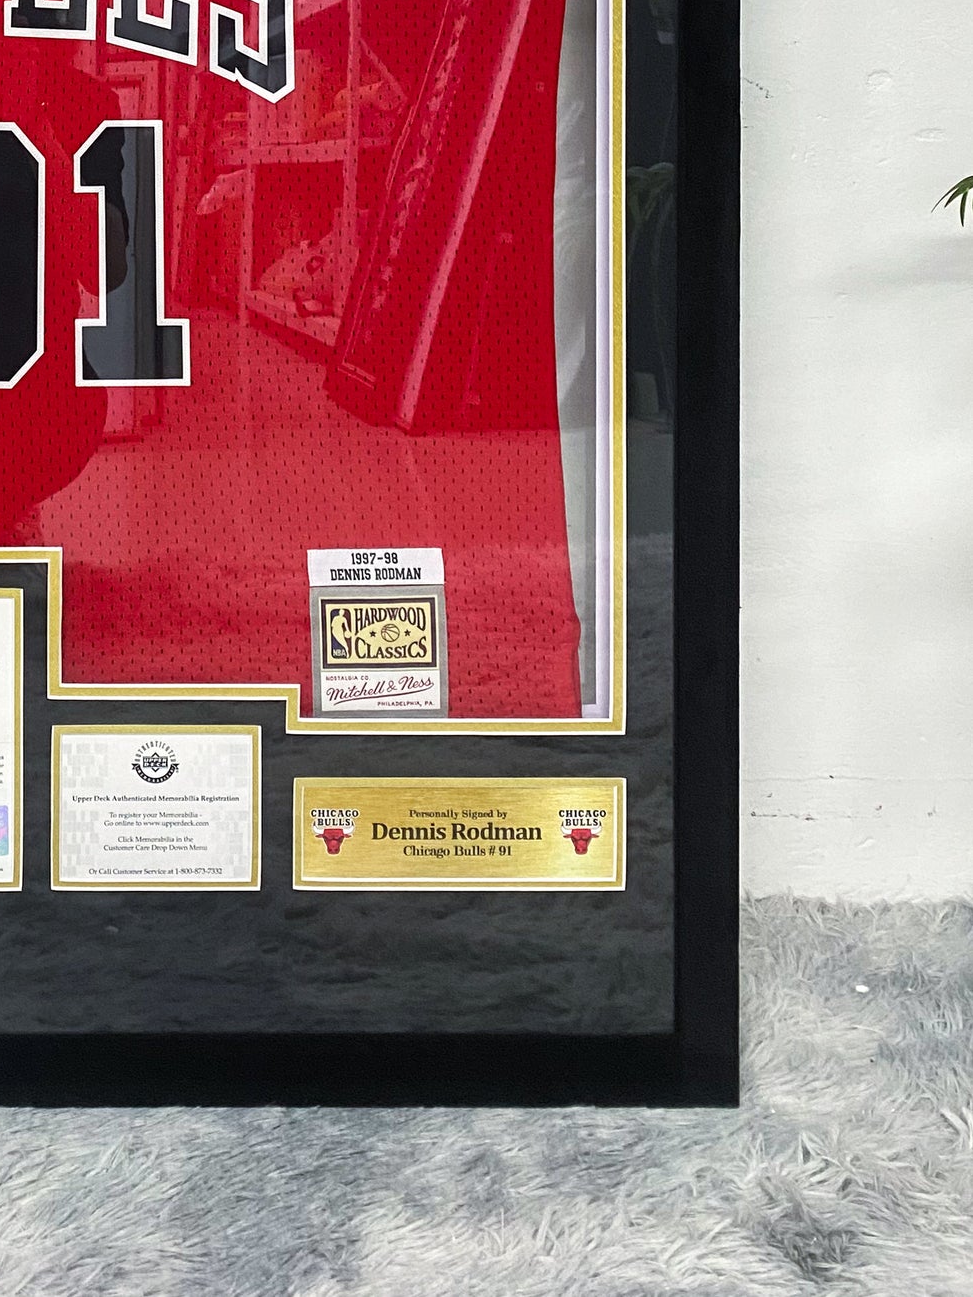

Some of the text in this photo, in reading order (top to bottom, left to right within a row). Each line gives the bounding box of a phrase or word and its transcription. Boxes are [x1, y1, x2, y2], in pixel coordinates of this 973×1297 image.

[351, 552, 398, 565] 1997-98
[330, 568, 422, 581] DENNIS RODMAN
[354, 606, 426, 635] HARDWOOD
[332, 648, 346, 657] NBA
[354, 636, 427, 660] CLASSICS
[326, 676, 434, 702] Mitchell & Ness
[310, 809, 359, 818] CHICAGO
[409, 810, 508, 820] Personally Signed by
[558, 809, 606, 818] CHICAGO
[317, 818, 351, 826] BULLS
[565, 818, 600, 826] BULLS
[372, 822, 542, 840] Dennis Rodman
[404, 846, 512, 858] Chicago Bulls # 91
